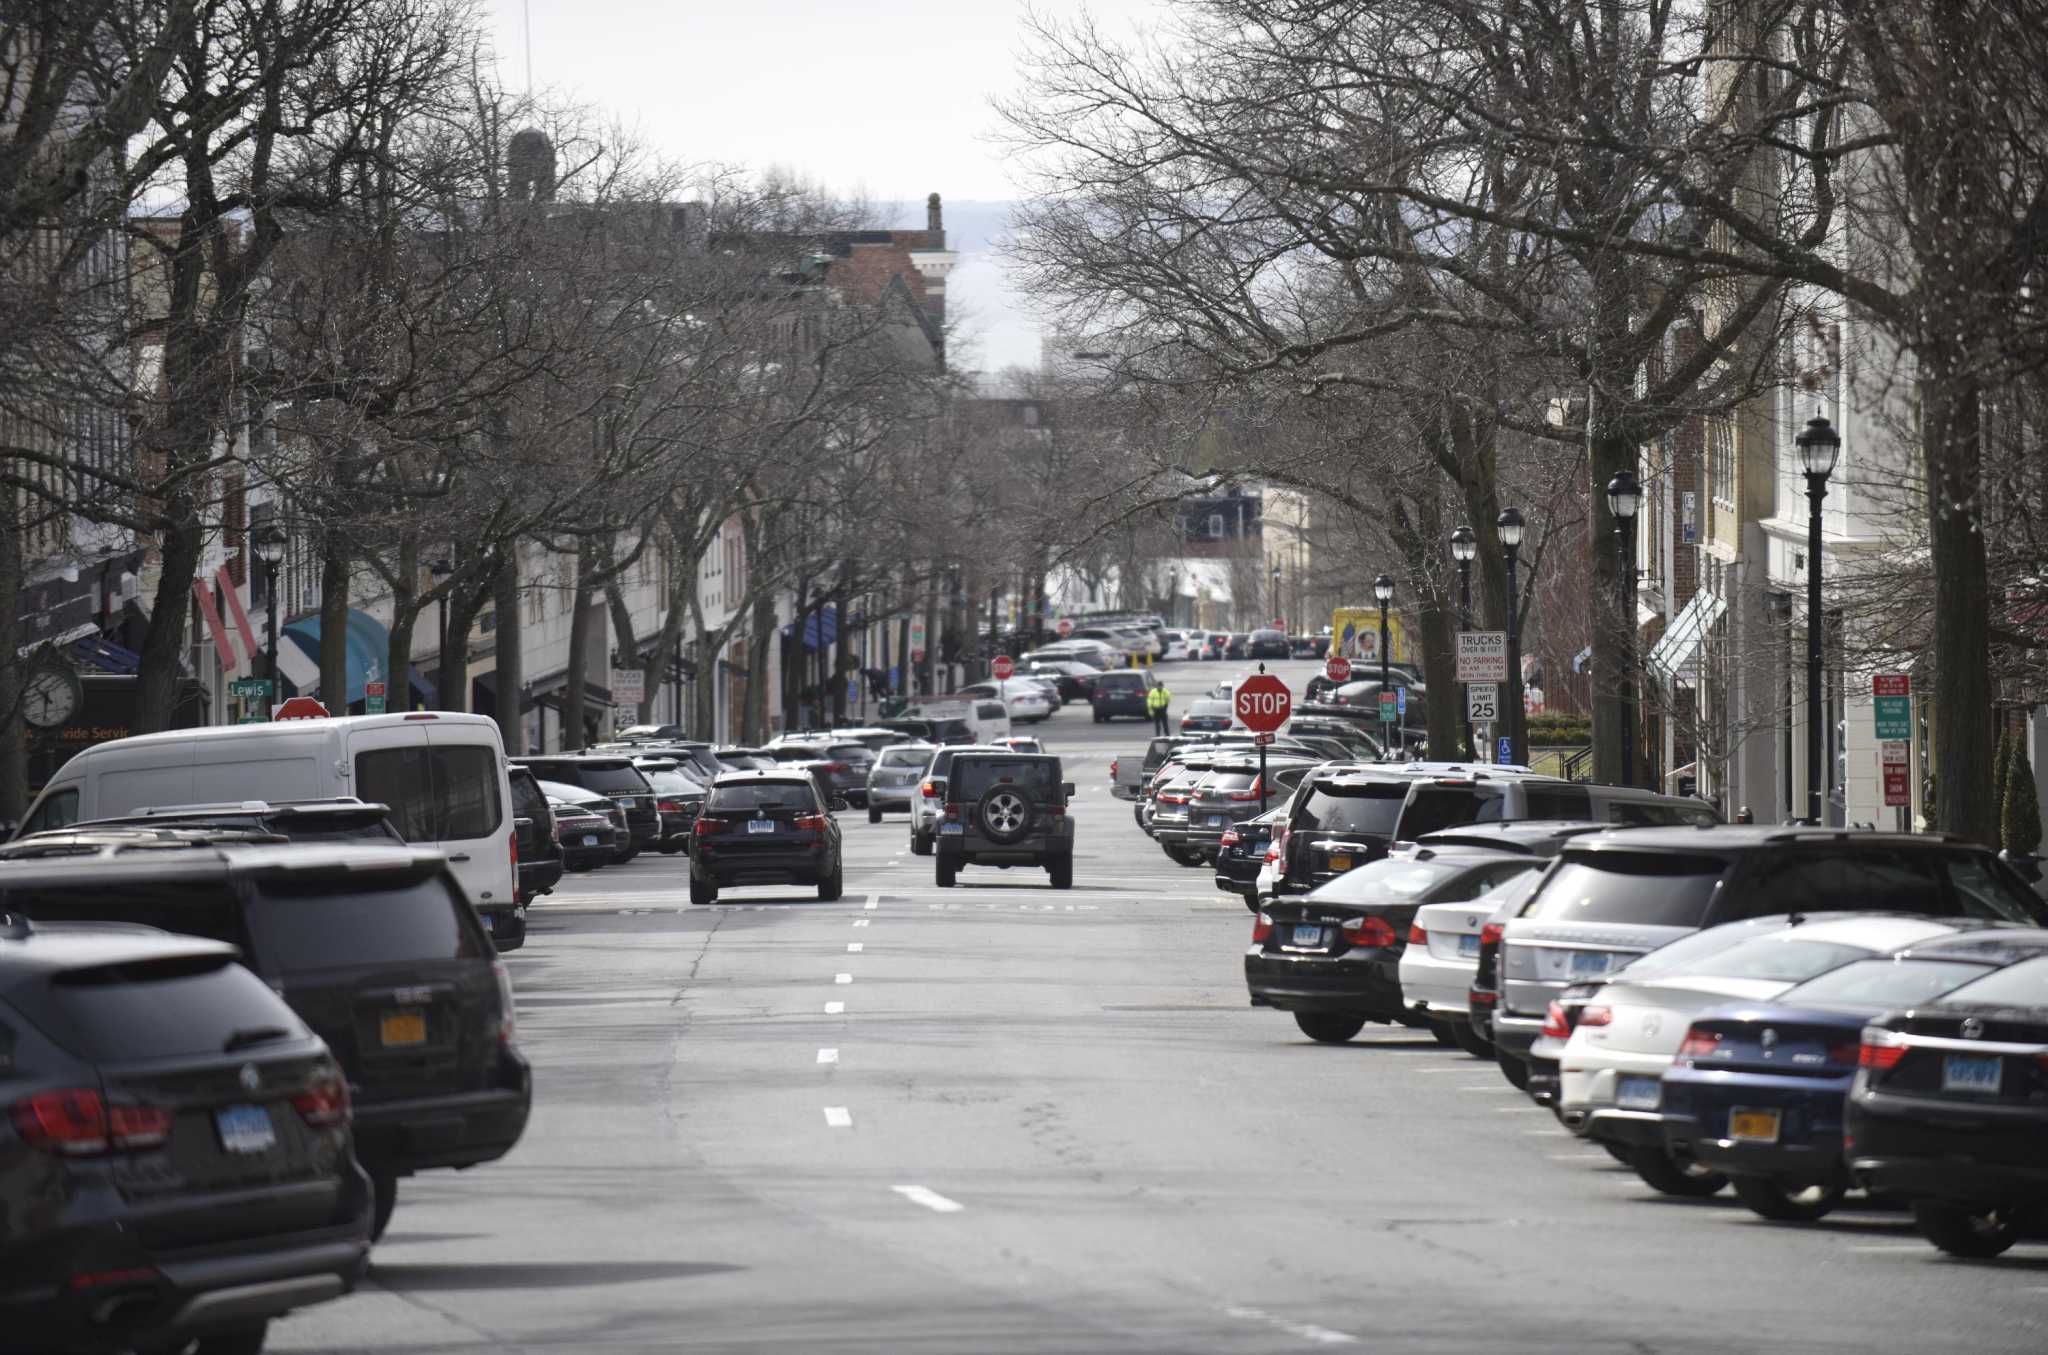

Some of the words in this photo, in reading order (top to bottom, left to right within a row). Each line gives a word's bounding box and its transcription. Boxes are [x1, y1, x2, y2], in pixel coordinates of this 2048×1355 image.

[1461, 635, 1502, 646] TRUCKS
[1460, 657, 1470, 665] NO
[1473, 656, 1504, 665] PARKING
[992, 663, 1013, 673] STOP
[1328, 664, 1349, 674] STOP
[231, 684, 264, 697] Lewis
[1239, 693, 1288, 715] STOP
[1472, 703, 1495, 718] 25
[622, 714, 636, 725] 25
